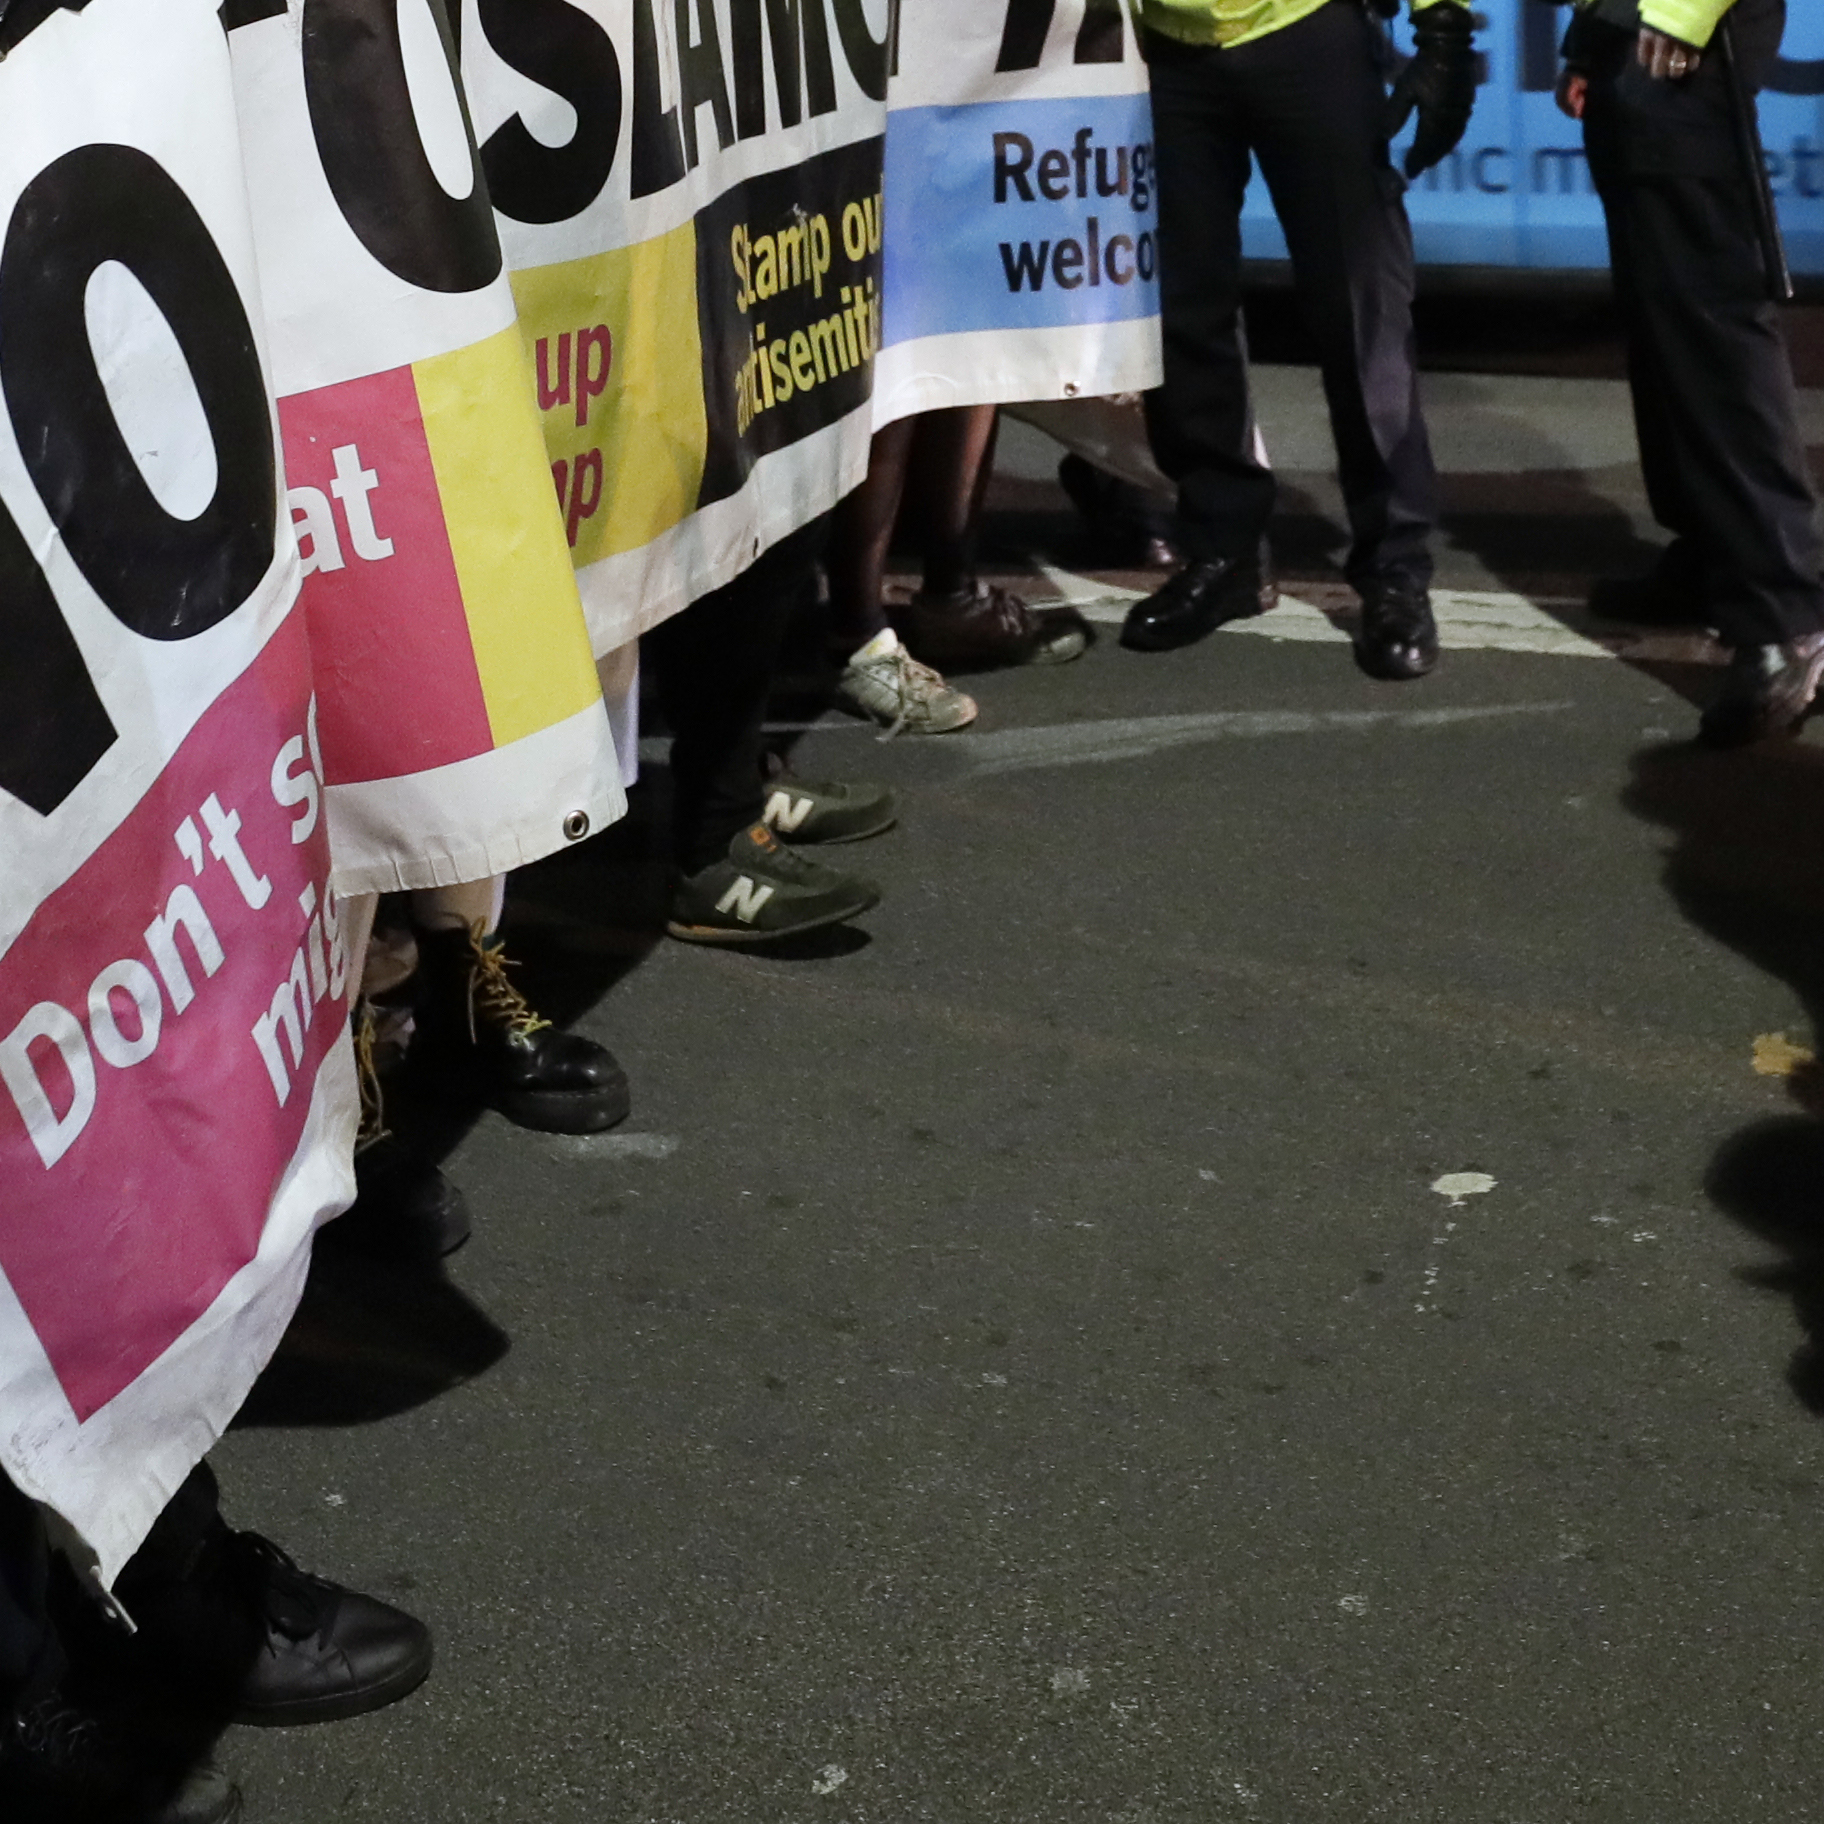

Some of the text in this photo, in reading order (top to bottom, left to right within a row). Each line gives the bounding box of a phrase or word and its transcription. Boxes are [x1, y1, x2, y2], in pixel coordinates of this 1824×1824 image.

[731, 214, 830, 314] Stamp
[536, 323, 612, 427] up
[715, 875, 774, 924] N
